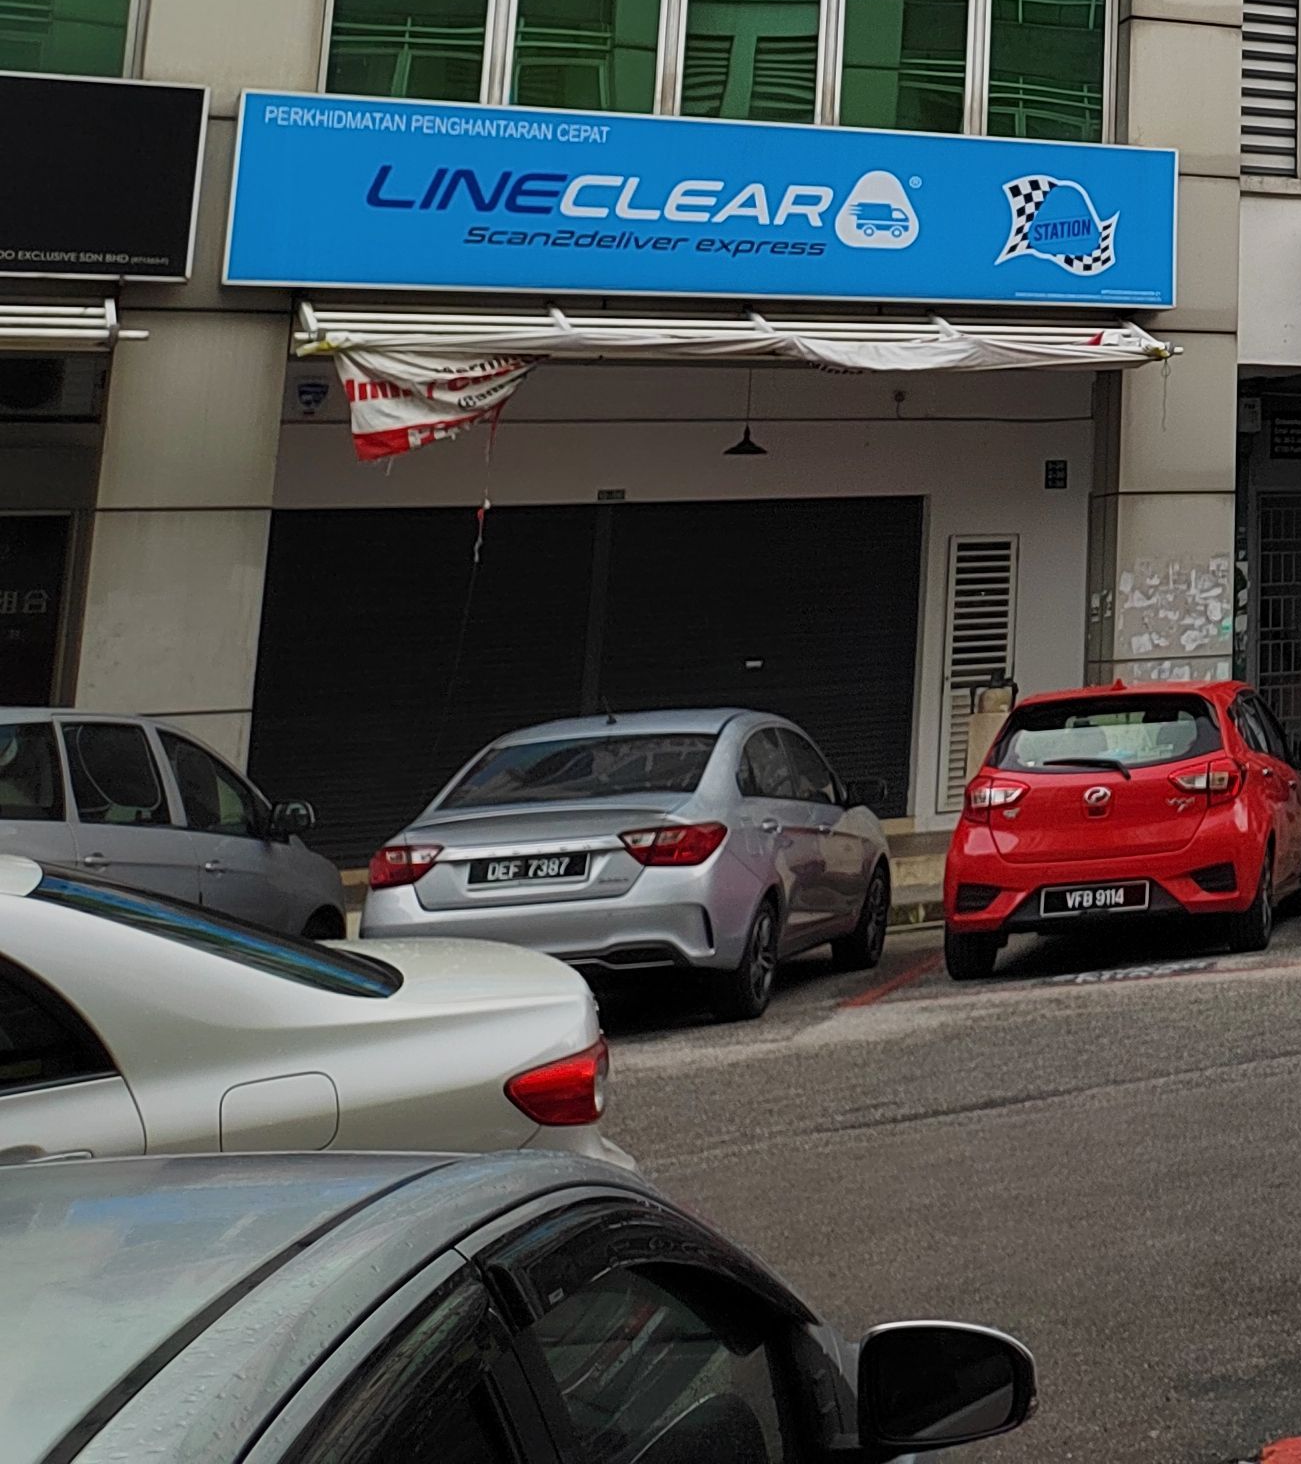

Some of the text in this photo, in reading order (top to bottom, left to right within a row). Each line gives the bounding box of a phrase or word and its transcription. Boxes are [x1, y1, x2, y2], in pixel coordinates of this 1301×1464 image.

[264, 106, 610, 144] PERKHIDMATAN PENGHANTARAN CEPAT
[365, 164, 834, 228] LINECLEAR
[463, 226, 827, 258] Scan2deliver express
[1033, 218, 1093, 242] STATION
[18, 250, 77, 262] EXCLUSIVE
[79, 252, 103, 263] SDN
[105, 253, 129, 264] BHD
[487, 857, 570, 881] DEF 7387
[1065, 887, 1125, 909] VFB 9114
